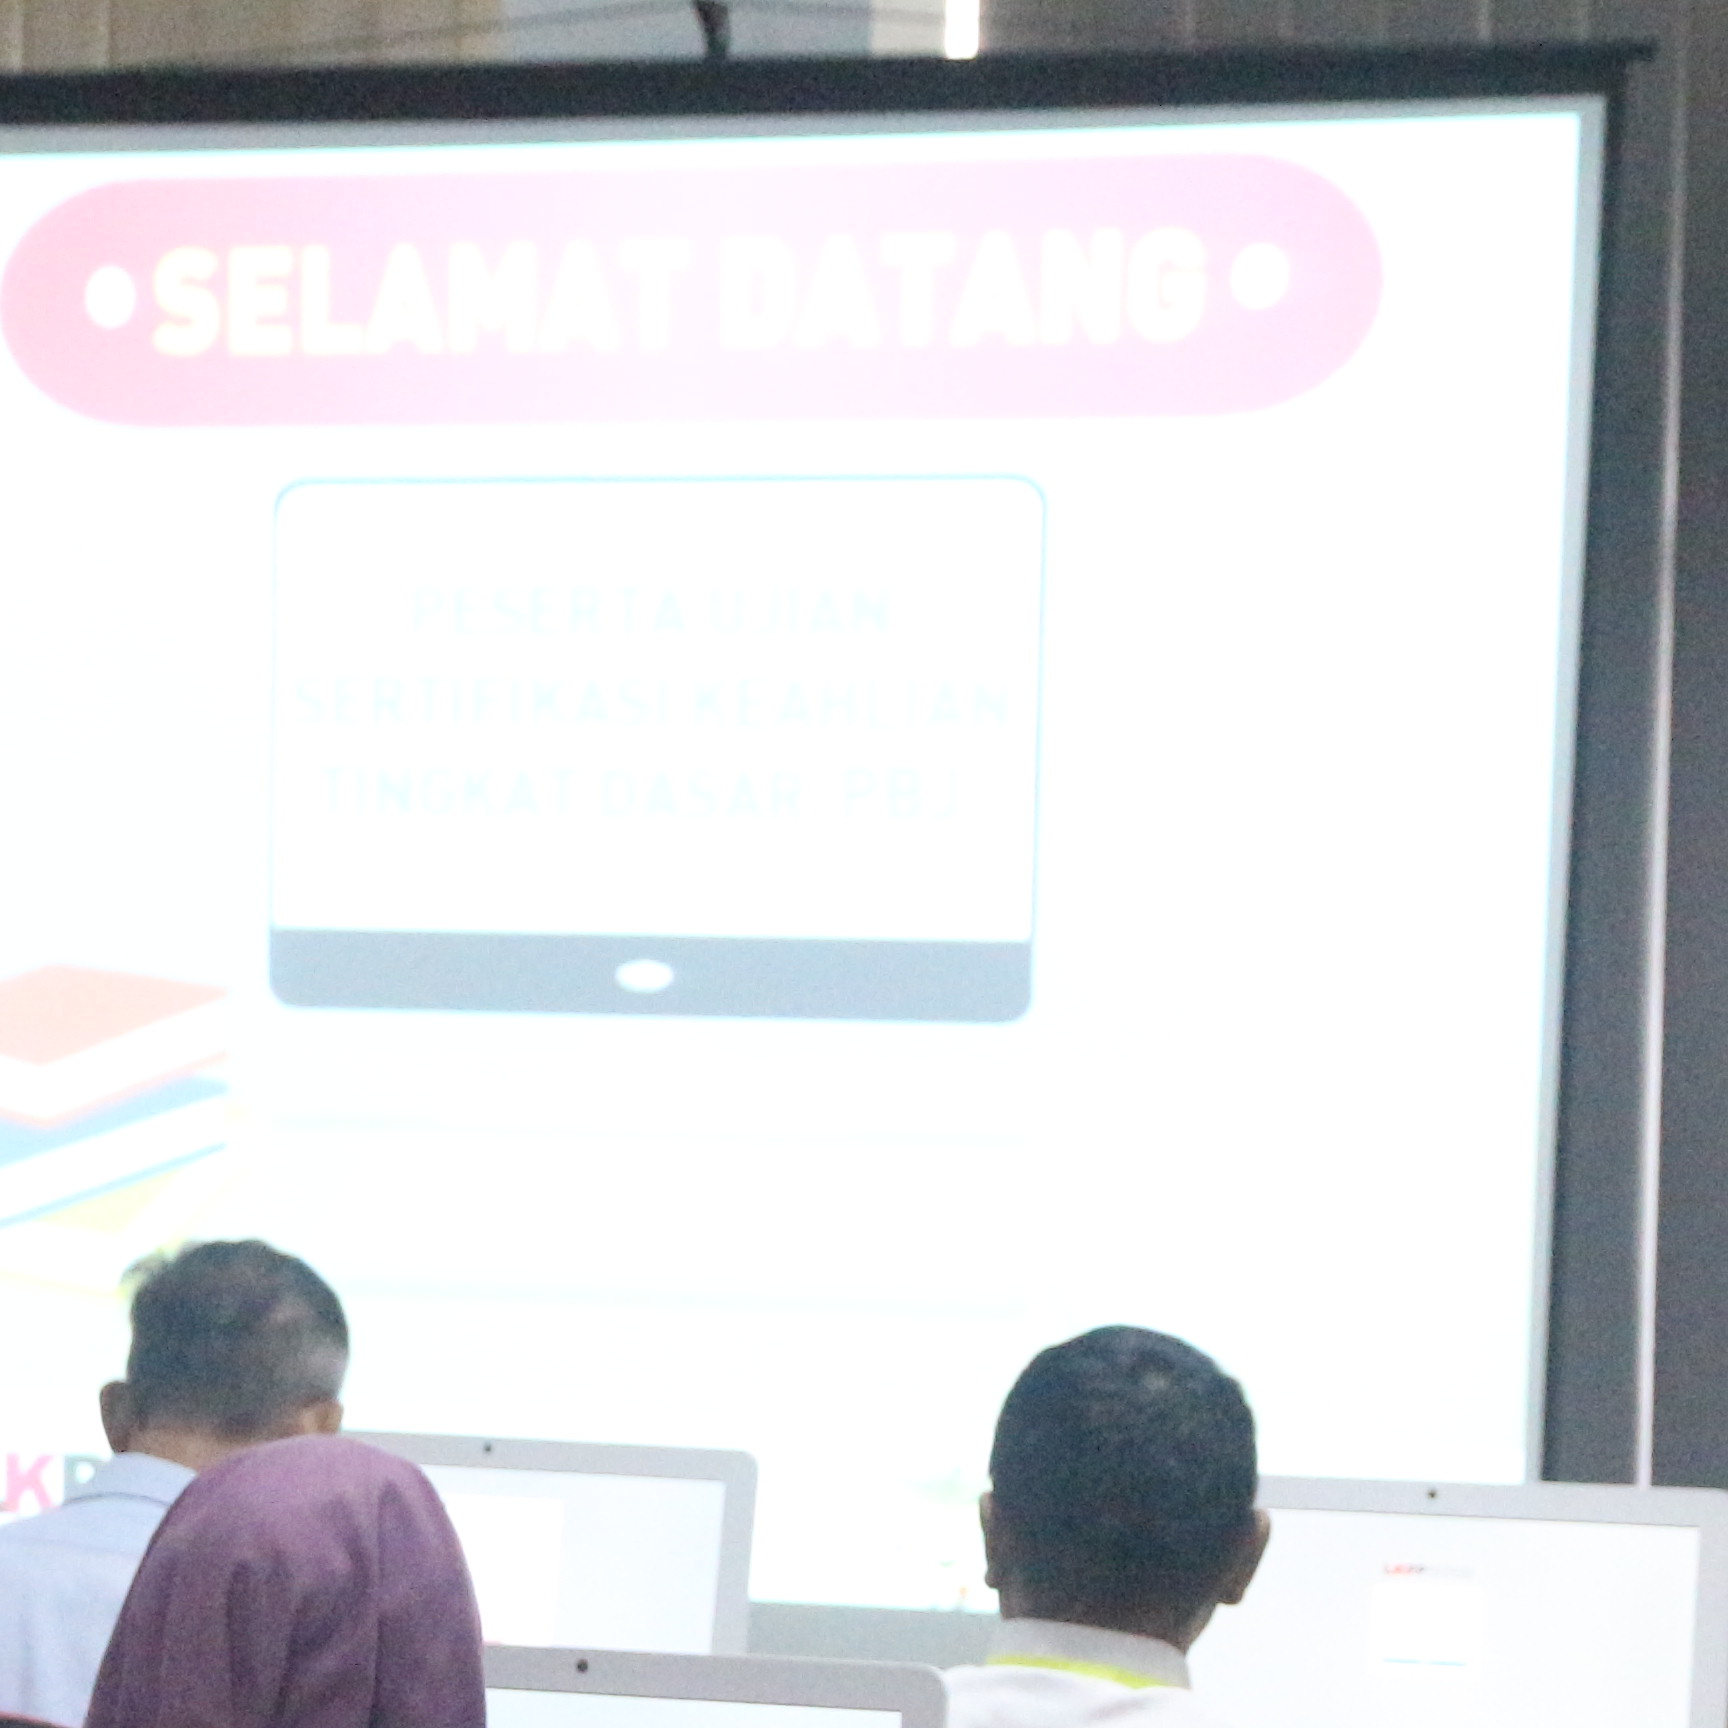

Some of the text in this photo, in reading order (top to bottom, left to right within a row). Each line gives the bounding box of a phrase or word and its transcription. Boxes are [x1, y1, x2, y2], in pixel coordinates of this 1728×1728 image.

[151, 225, 1209, 358] SELAMAT DATANG
[322, 765, 576, 816] TINGKAT
[602, 768, 803, 820] DASAR
